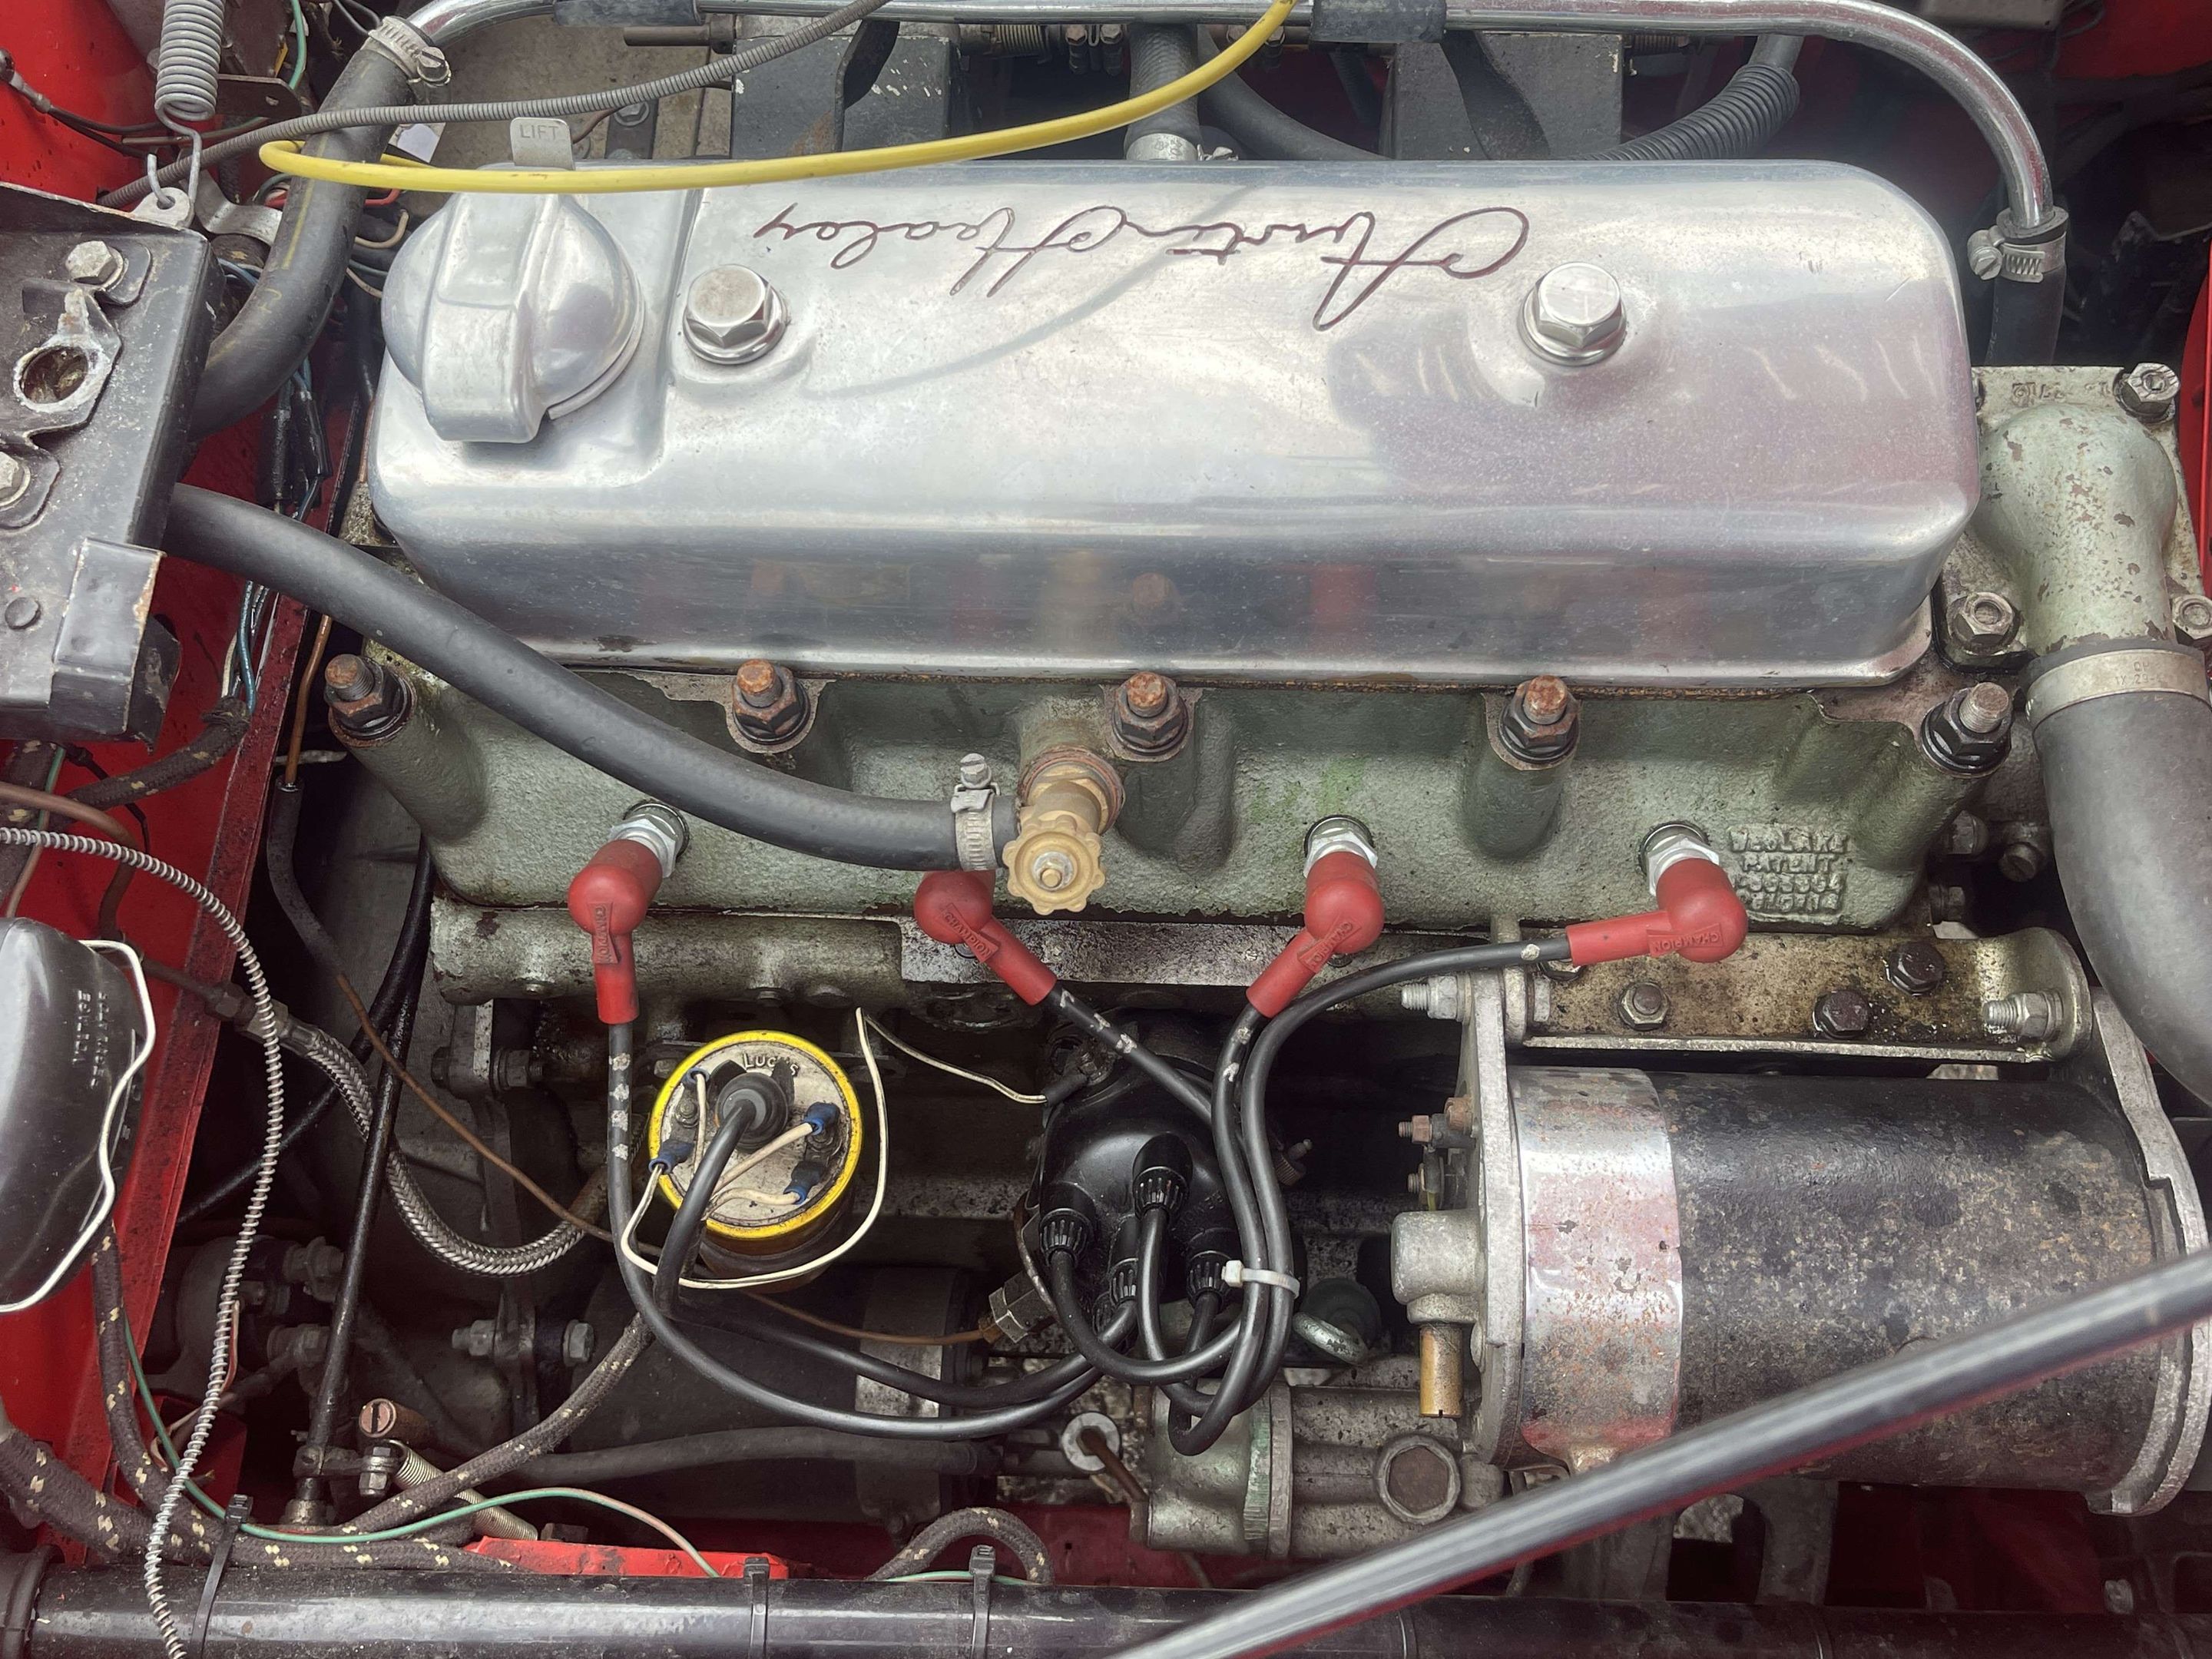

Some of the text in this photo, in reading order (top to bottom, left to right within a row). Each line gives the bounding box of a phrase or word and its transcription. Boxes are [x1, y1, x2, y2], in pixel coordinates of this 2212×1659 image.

[519, 124, 558, 139] LIFT
[753, 201, 1530, 333] Austin Healey
[944, 911, 992, 957] CHAMPION
[1651, 932, 1720, 952] CHAMPION
[743, 1052, 799, 1077] LUCS
